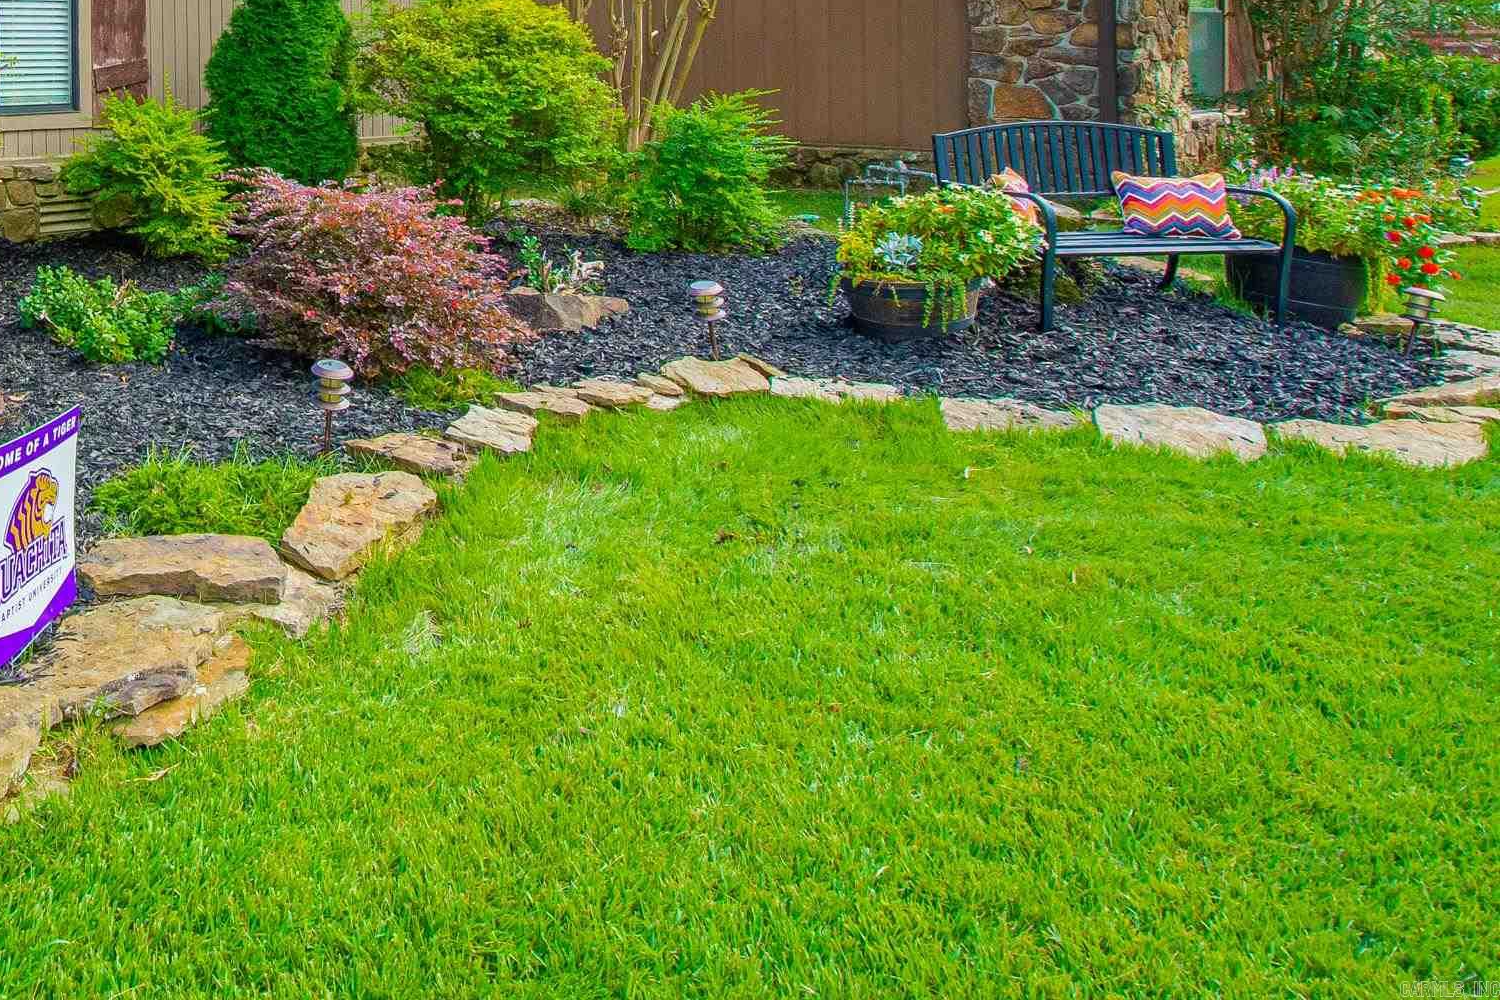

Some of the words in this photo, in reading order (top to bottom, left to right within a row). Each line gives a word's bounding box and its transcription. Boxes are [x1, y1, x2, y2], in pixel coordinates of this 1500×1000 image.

[25, 437, 41, 457] OF
[43, 433, 50, 448] A
[52, 416, 77, 441] TIGER
